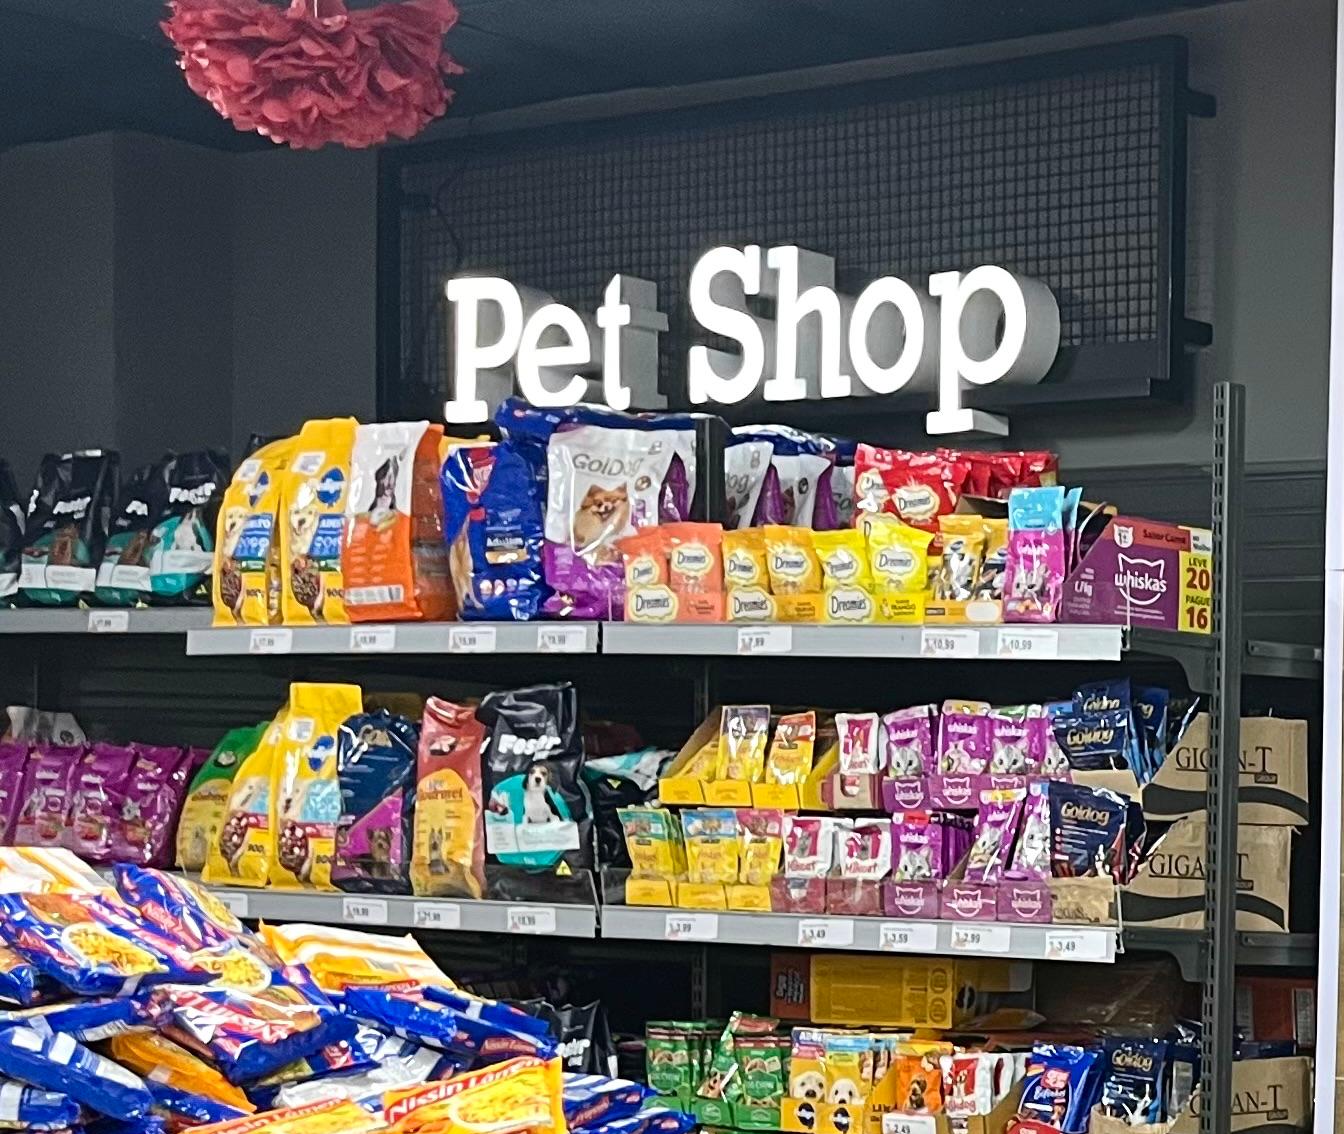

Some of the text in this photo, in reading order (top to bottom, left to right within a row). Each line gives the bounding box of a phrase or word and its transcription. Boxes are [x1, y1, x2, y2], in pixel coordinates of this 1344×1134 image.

[444, 244, 1028, 436] Pet Shop
[1115, 570, 1167, 593] whiskas
[1186, 567, 1210, 591] 20
[1186, 606, 1208, 629] 16
